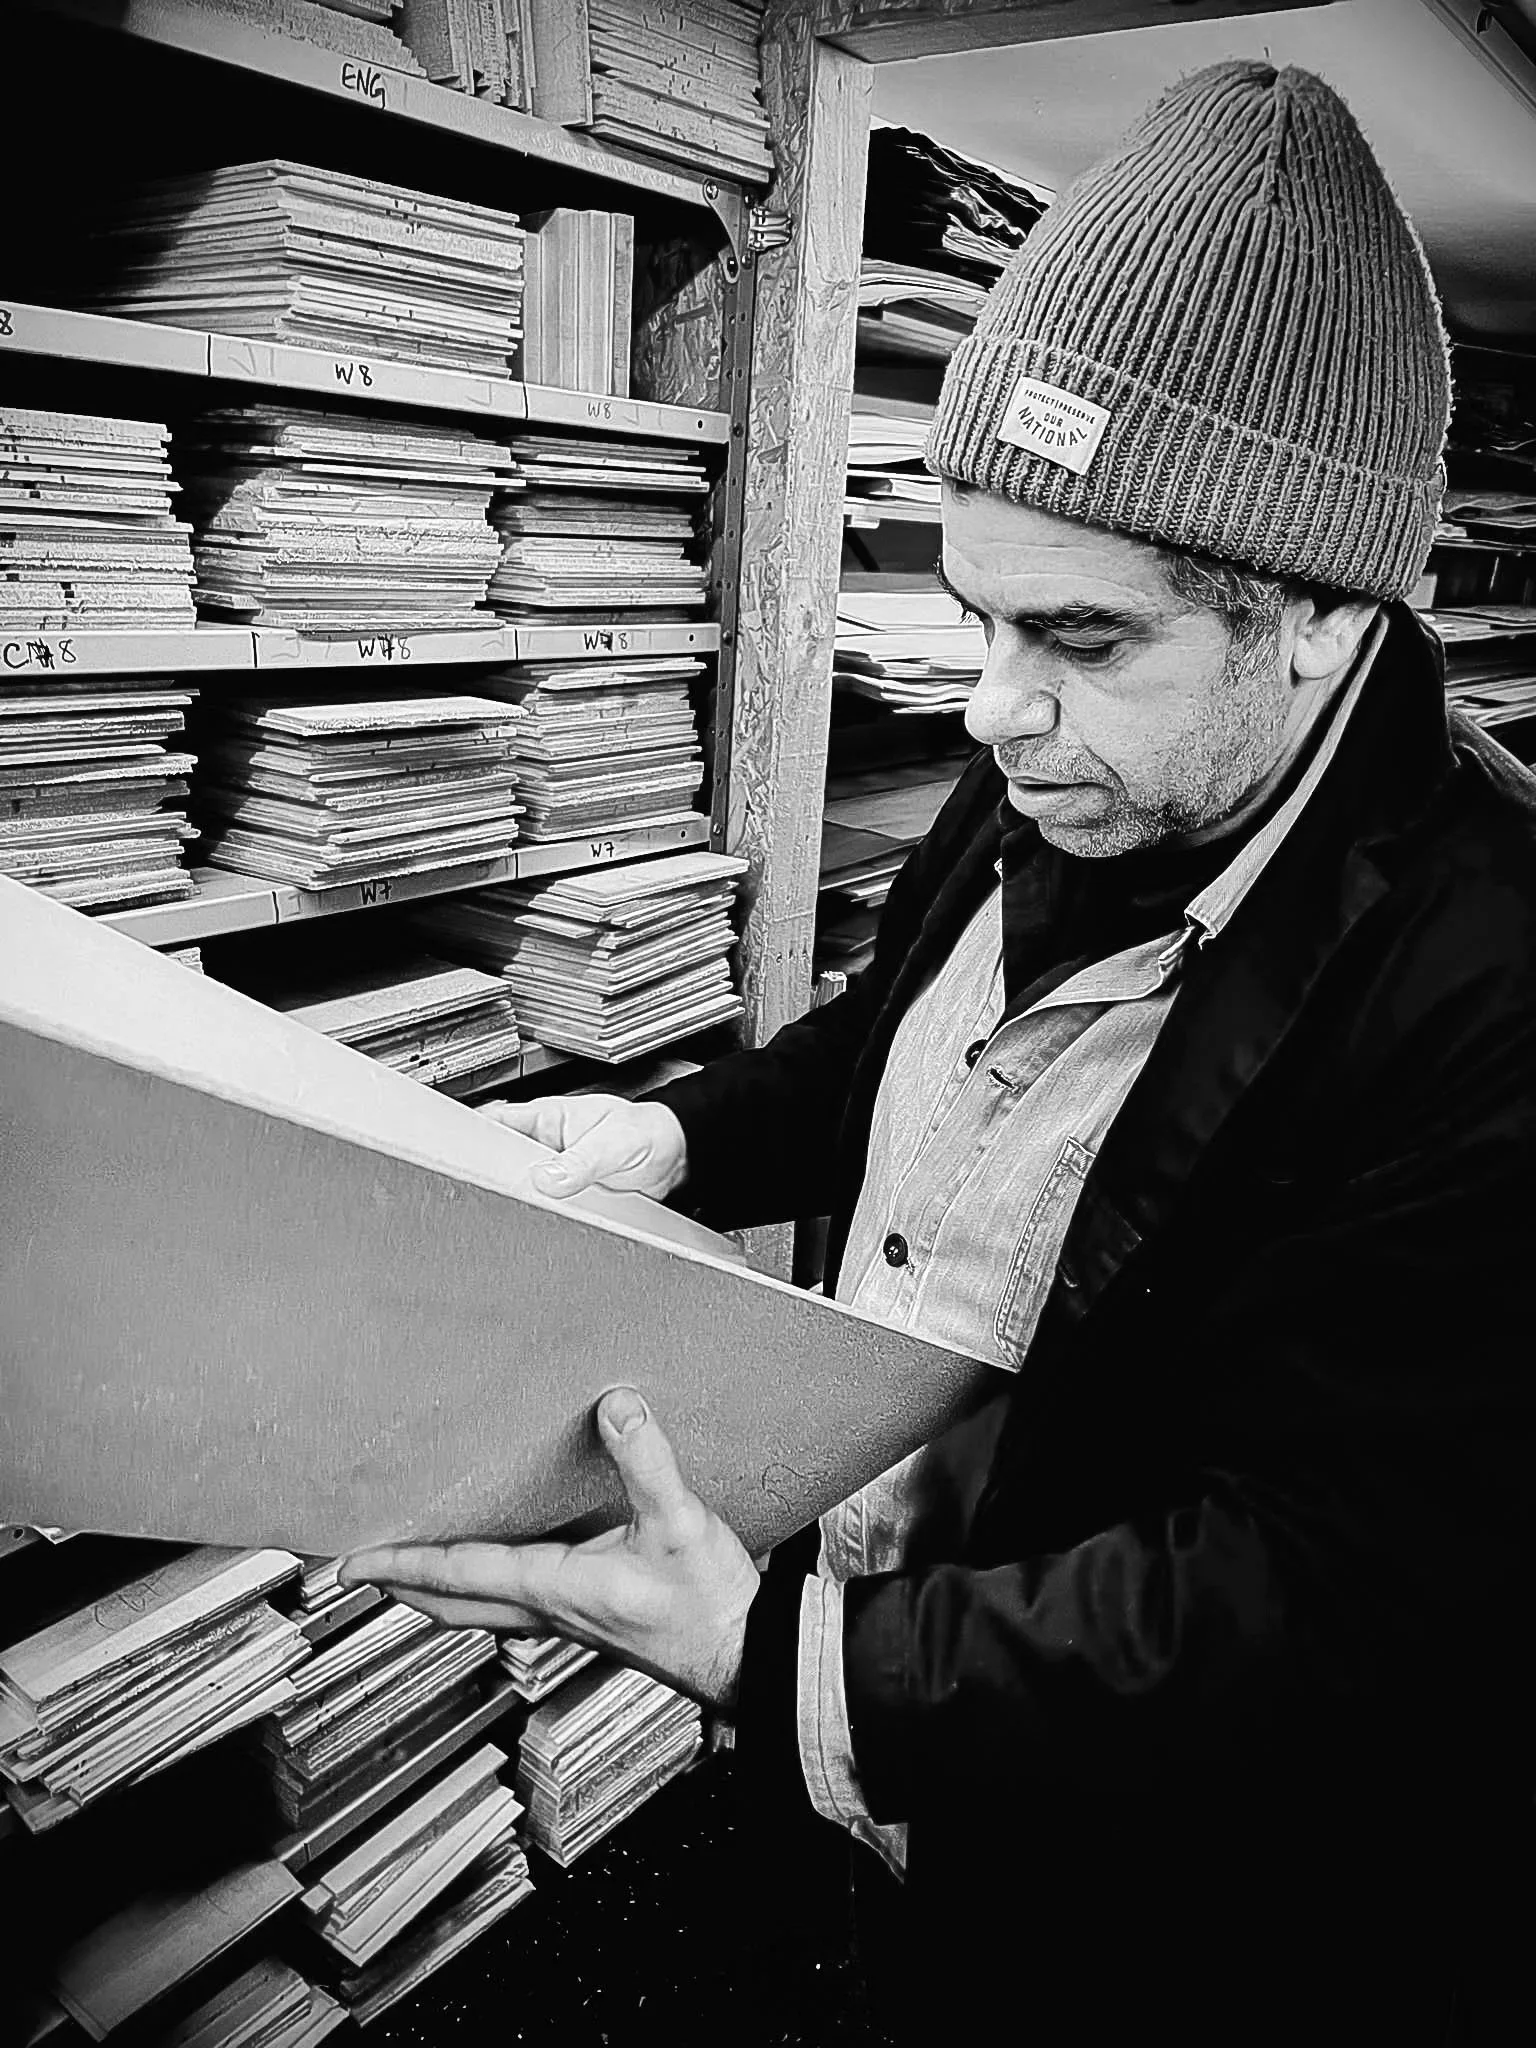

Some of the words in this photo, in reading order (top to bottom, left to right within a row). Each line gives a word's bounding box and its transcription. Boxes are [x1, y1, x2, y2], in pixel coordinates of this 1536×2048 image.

[342, 62, 386, 110] ENG
[1017, 405, 1088, 447] NATIONAL
[1043, 412, 1064, 428] OUR
